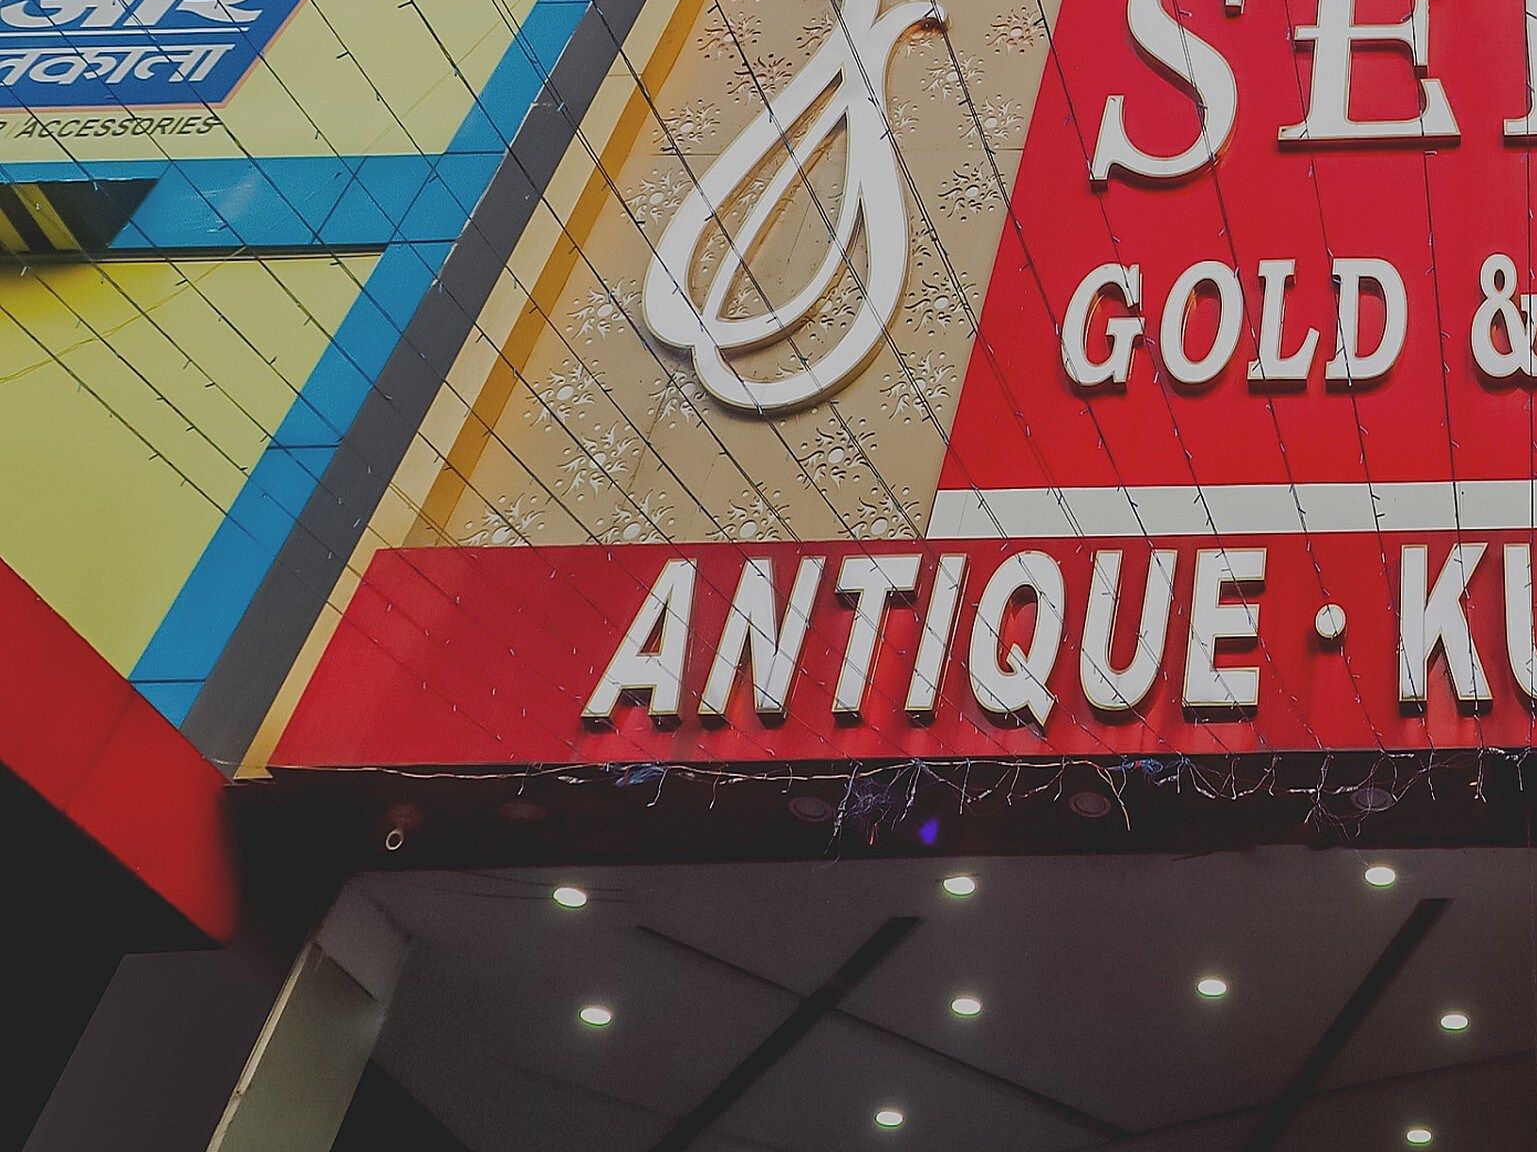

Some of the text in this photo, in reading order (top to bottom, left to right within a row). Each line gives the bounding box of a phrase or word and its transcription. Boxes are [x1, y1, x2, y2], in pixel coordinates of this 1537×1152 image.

[15, 116, 218, 139] ACCESSORIES
[1061, 254, 1408, 389] GOLD
[580, 547, 1267, 729] ANTIQUE
